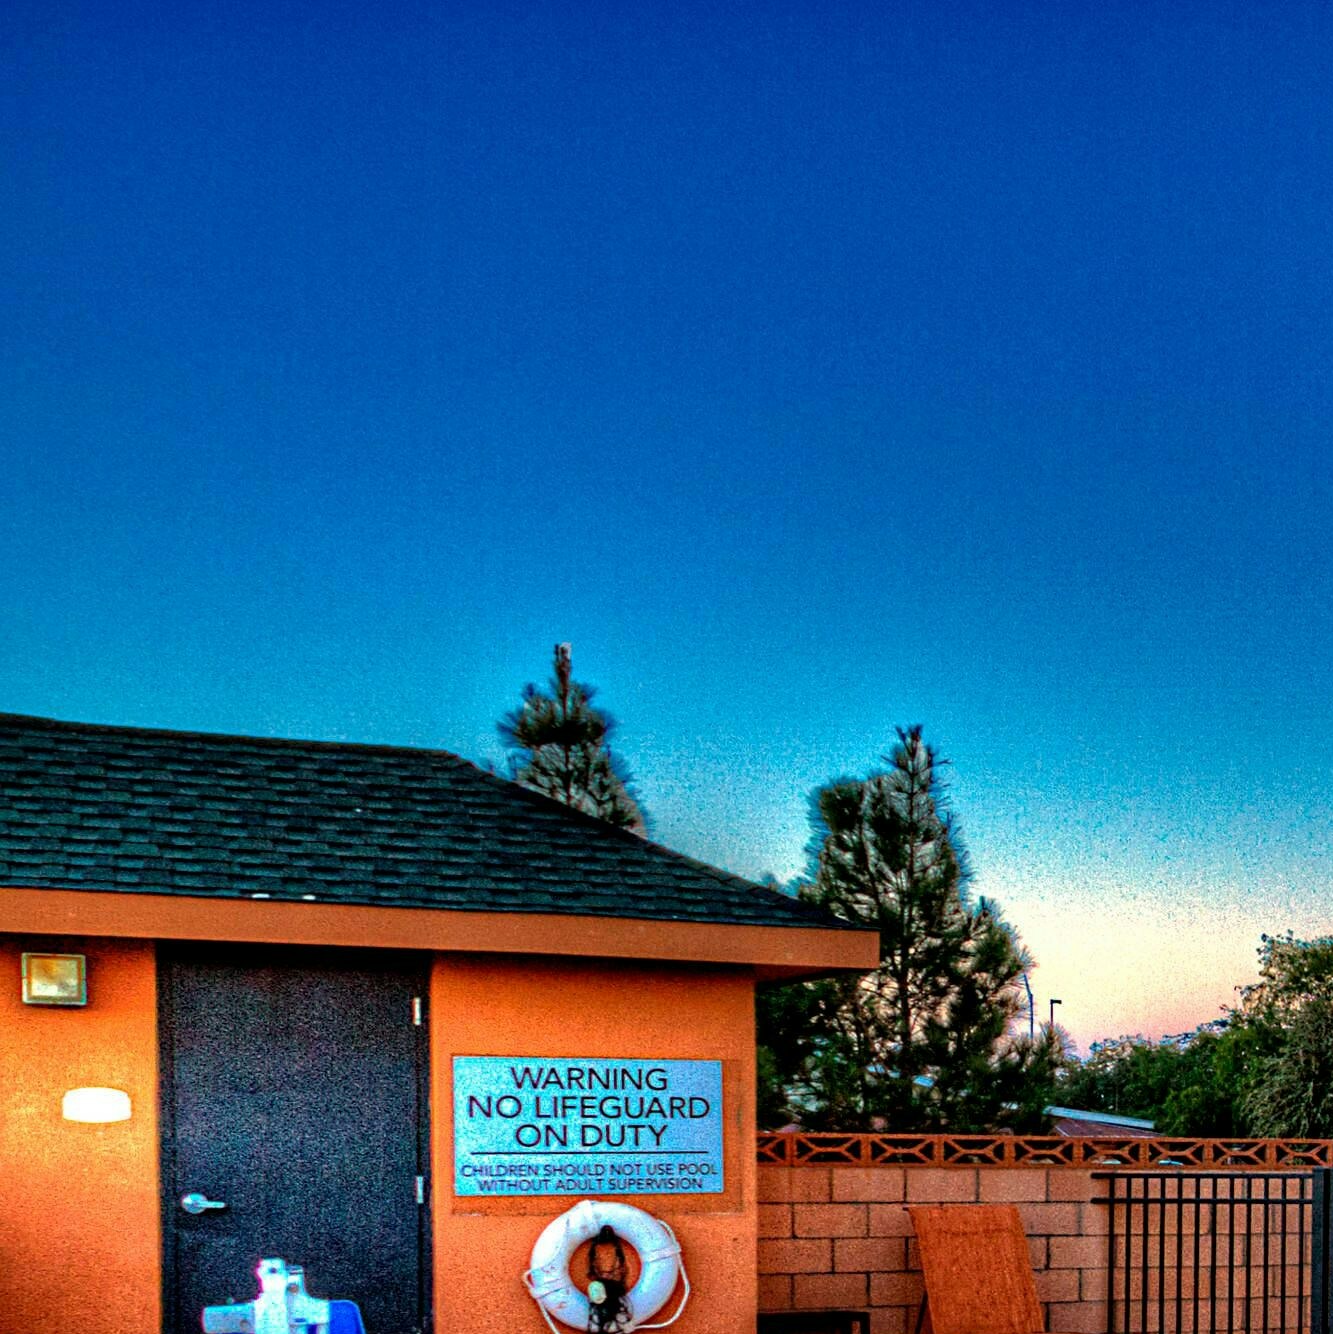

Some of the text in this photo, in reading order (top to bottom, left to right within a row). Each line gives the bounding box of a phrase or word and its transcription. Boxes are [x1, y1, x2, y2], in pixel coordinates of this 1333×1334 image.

[511, 1067, 668, 1091] WARNING
[468, 1096, 710, 1119] NO LIFEGUARD
[515, 1124, 668, 1147] ON DUTY
[461, 1163, 718, 1177] CHILDREN SHOULD NOT USE POOL
[478, 1178, 702, 1191] WITHOUT ADULT SUPERVISION
